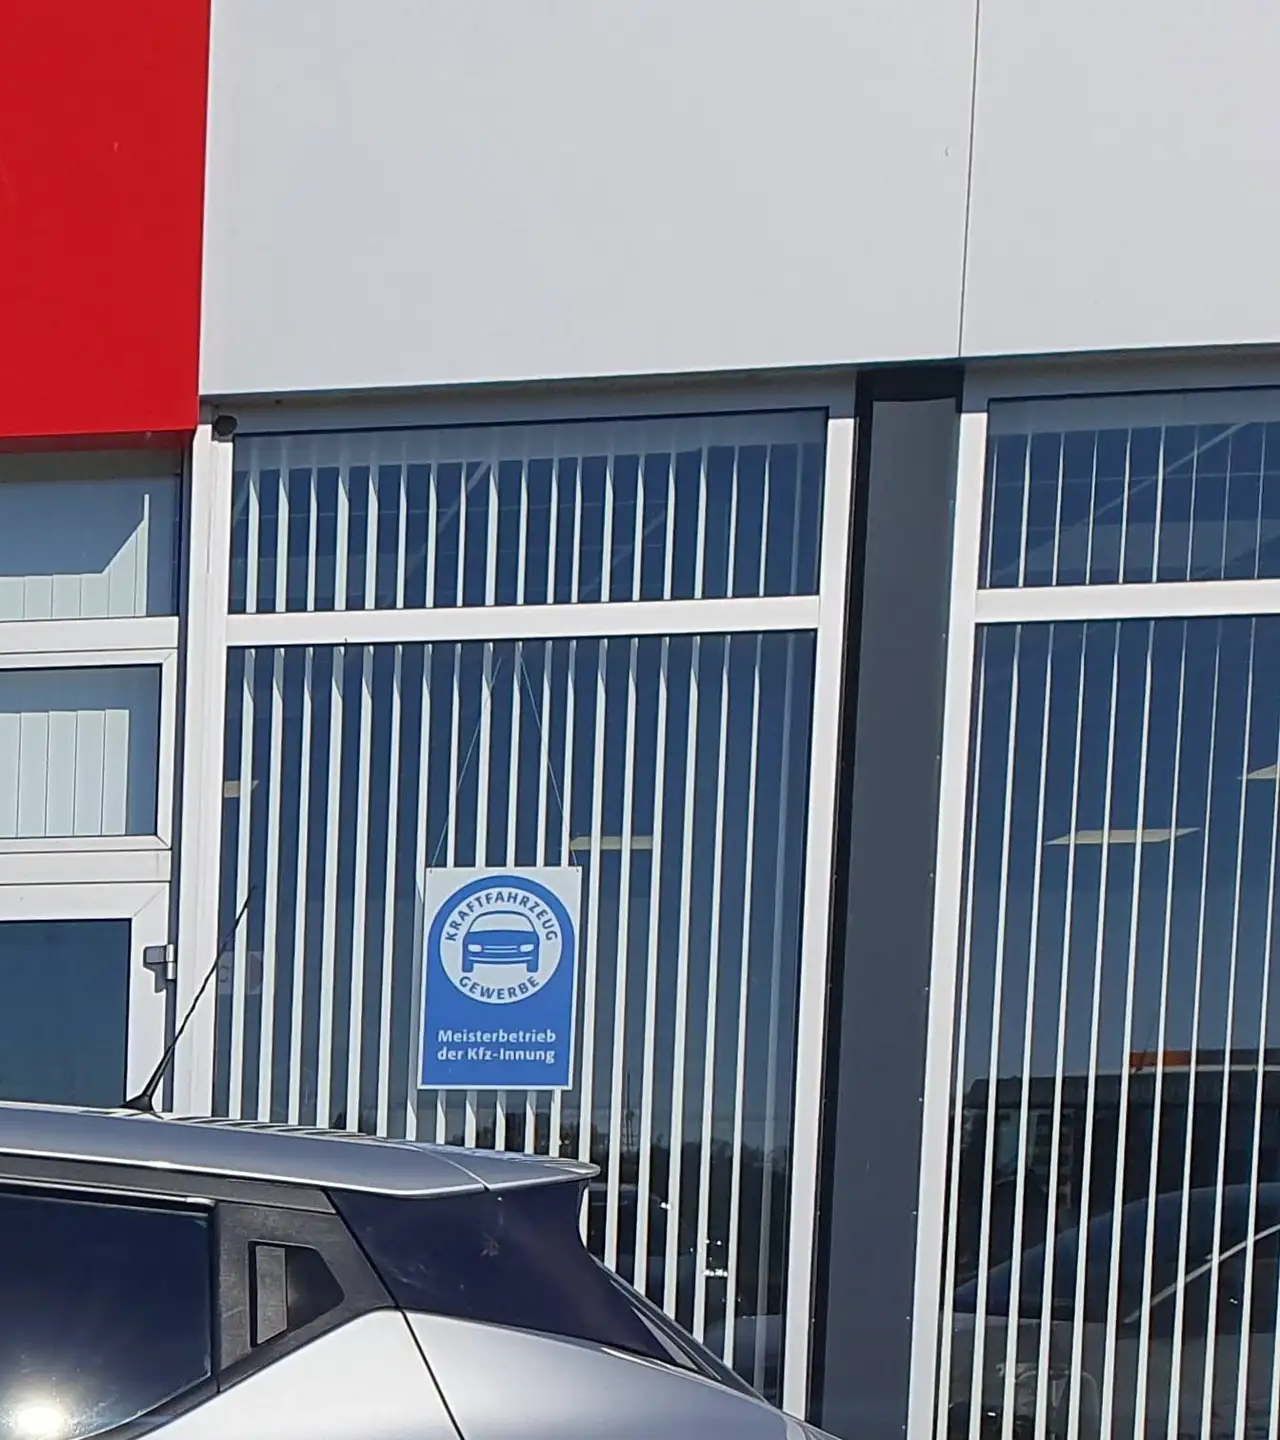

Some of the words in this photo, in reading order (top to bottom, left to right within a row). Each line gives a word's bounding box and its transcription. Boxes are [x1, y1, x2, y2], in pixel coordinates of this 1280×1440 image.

[444, 890, 559, 943] KRAFTFAHRZEUG
[458, 975, 541, 1001] GEWERBE
[437, 1028, 557, 1045] Meisterbetrieb
[437, 1047, 464, 1062] der
[467, 1047, 556, 1064] Kfz-Innung
